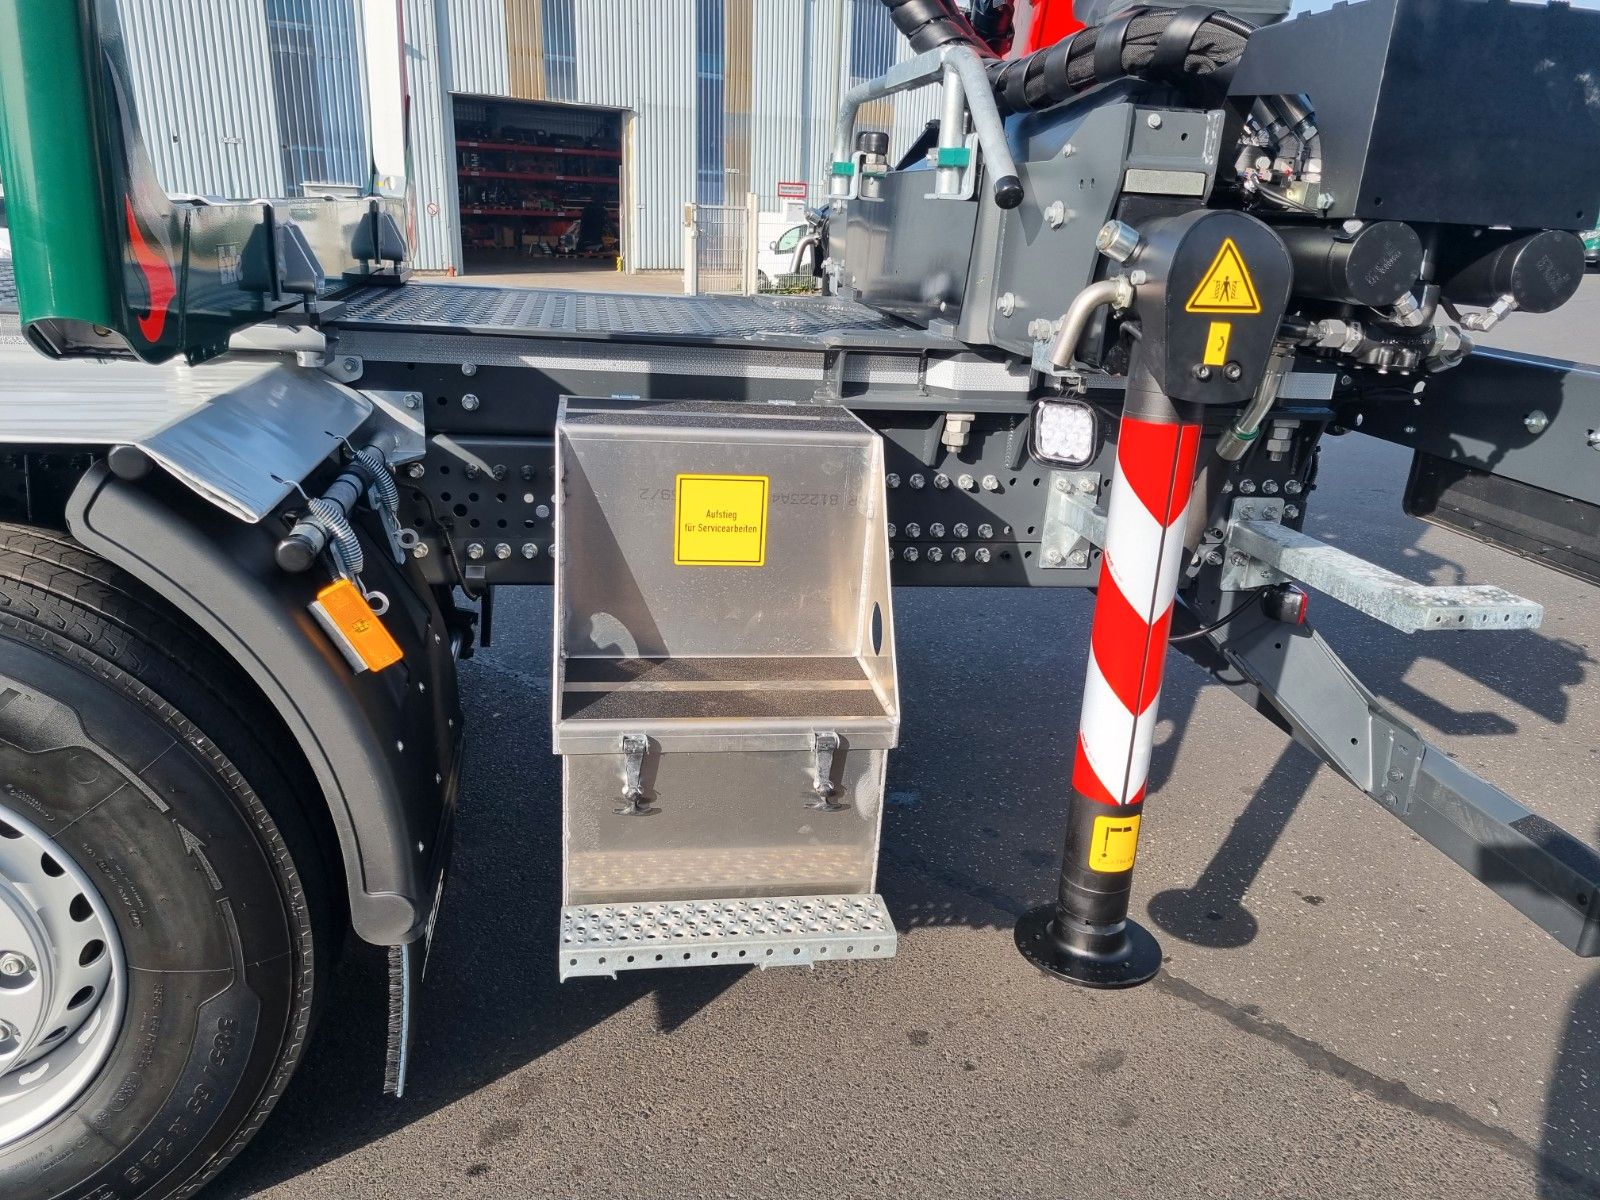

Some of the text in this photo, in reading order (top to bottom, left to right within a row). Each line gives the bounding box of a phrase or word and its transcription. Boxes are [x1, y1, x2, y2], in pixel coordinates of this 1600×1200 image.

[705, 509, 738, 521] Aufstieg
[684, 522, 758, 534] für Servicearbeiten
